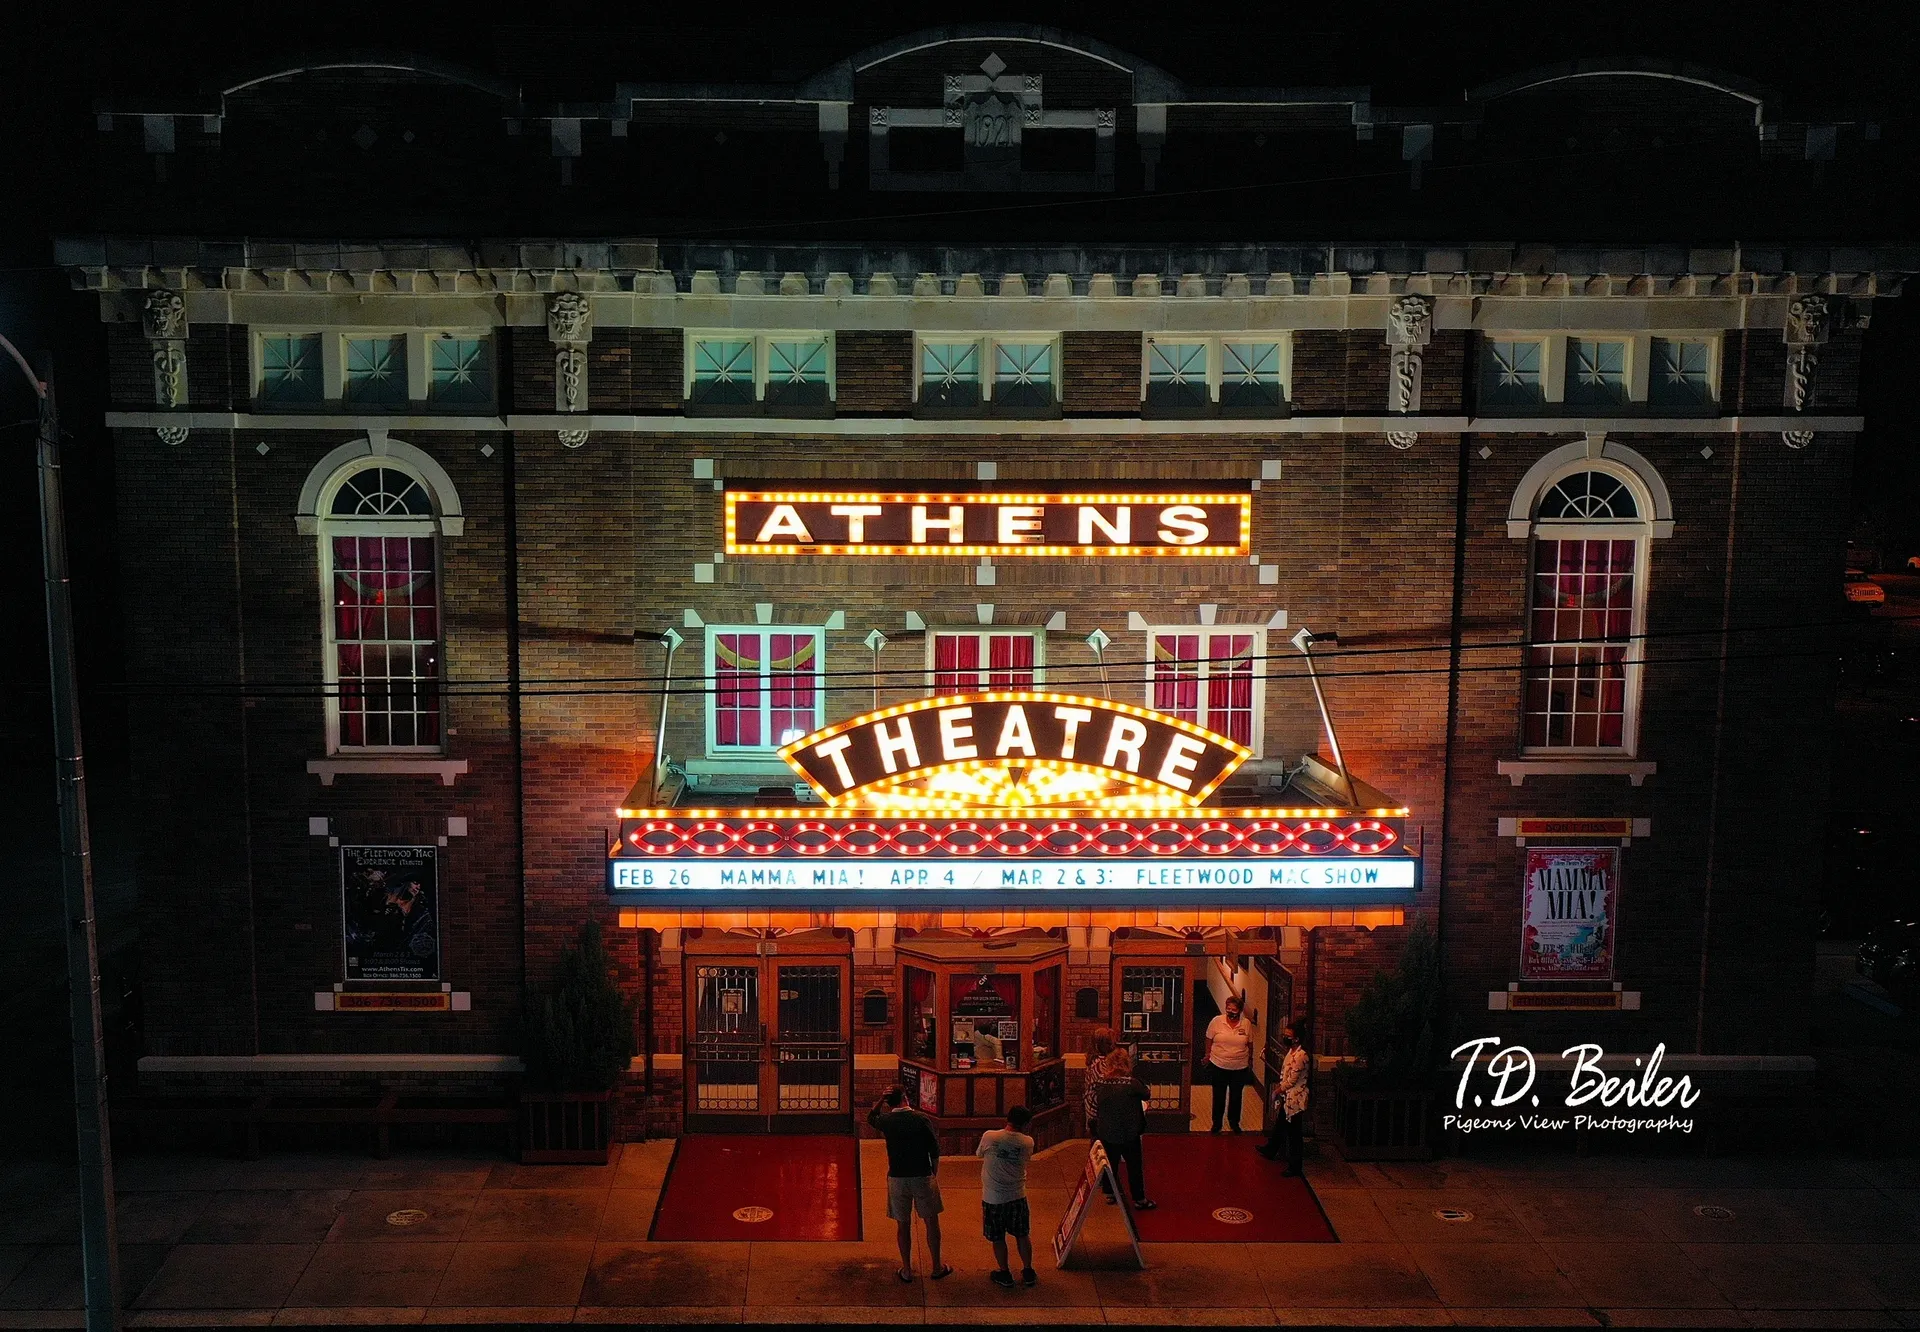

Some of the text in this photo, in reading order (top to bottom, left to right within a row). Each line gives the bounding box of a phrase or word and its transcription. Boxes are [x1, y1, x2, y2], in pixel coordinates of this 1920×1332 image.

[974, 115, 1014, 148] 1921
[756, 504, 1209, 545] ATHENS
[815, 704, 1207, 792] THEATRE
[1581, 823, 1606, 832] MISS
[345, 848, 434, 858] THE FLEETWOOD MAC
[356, 857, 396, 866] EXPERIENCE
[619, 868, 653, 886] FEB
[668, 868, 690, 886] 26
[720, 869, 796, 885] MAMMA
[812, 869, 864, 886] MIA!
[890, 868, 928, 886] APR
[943, 869, 955, 886] 4
[1001, 868, 1042, 886] MAR
[1057, 868, 1066, 885] 2
[1075, 868, 1086, 886] &
[1095, 868, 1113, 885] 3:
[1136, 868, 1254, 886] FLEETWOOD
[1269, 868, 1310, 885] MAC
[1324, 868, 1379, 885] SHOW
[1538, 868, 1607, 890] MAMMA
[1546, 891, 1596, 919] MIA!
